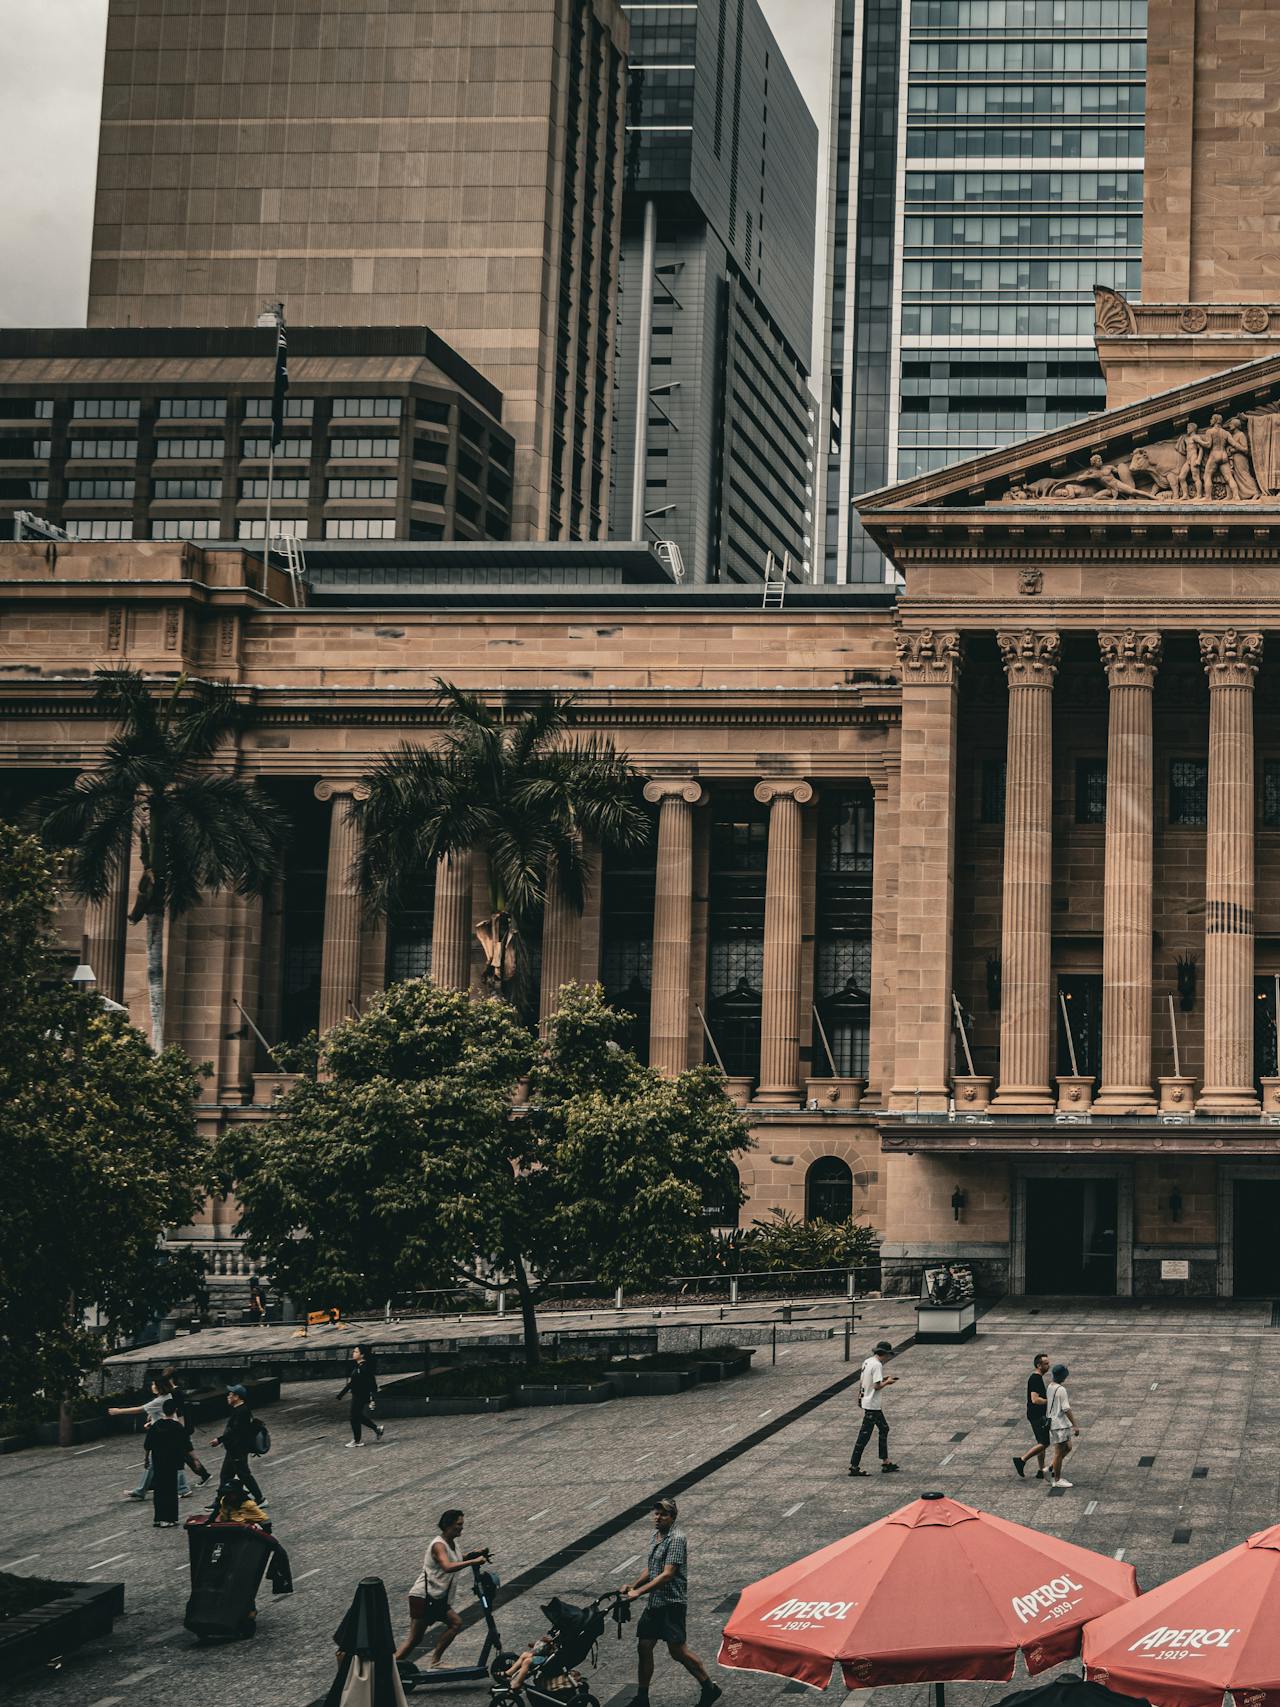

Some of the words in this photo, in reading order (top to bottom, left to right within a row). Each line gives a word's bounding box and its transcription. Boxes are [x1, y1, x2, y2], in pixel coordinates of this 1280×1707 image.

[1012, 1574, 1083, 1624] APEROL
[760, 1598, 854, 1621] APEROL
[1049, 1601, 1073, 1618] 1919
[781, 1621, 811, 1631] 1919
[1127, 1626, 1237, 1652] APEROL
[1155, 1650, 1189, 1660] 1919
